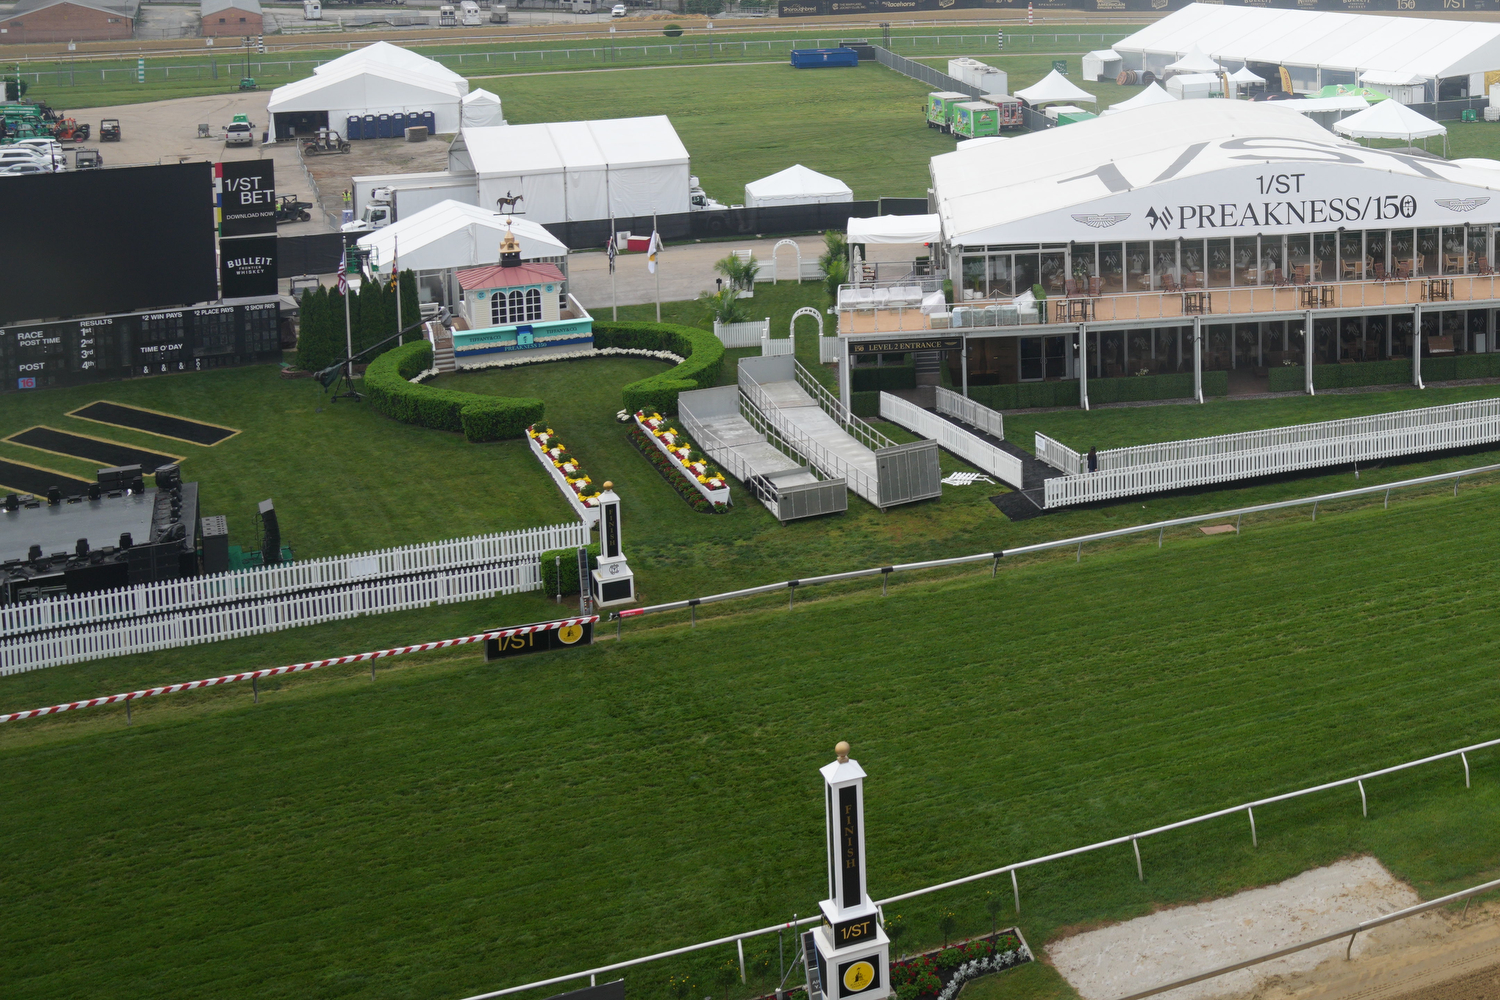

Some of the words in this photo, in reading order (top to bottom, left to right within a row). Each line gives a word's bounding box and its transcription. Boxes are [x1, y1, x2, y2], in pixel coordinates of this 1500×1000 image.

[1396, 0, 1416, 10] 150
[225, 176, 262, 192] 1/ST
[1255, 173, 1305, 195] 1/ST
[241, 189, 275, 205] BET
[226, 212, 259, 220] DOWNLOAD
[1177, 194, 1418, 231] PREAKNESS/150
[166, 311, 183, 319] PAYS
[80, 318, 113, 327] RESULTS
[17, 330, 44, 340] RACE
[80, 327, 92, 336] 1st
[20, 339, 41, 347] POST
[41, 337, 61, 345] TIME
[80, 338, 94, 348] 2nd
[868, 343, 894, 351] LEVEL
[900, 341, 942, 350] ENTRANCE
[140, 345, 159, 353] TIME
[504, 343, 538, 352] PREAKNESS
[81, 349, 94, 359] 3rd
[19, 362, 45, 372] POST
[81, 360, 95, 370] 4th
[20, 378, 34, 388] 16
[608, 508, 616, 546] FINISH
[844, 804, 856, 869] FINISH
[840, 921, 871, 940] 1/ST
